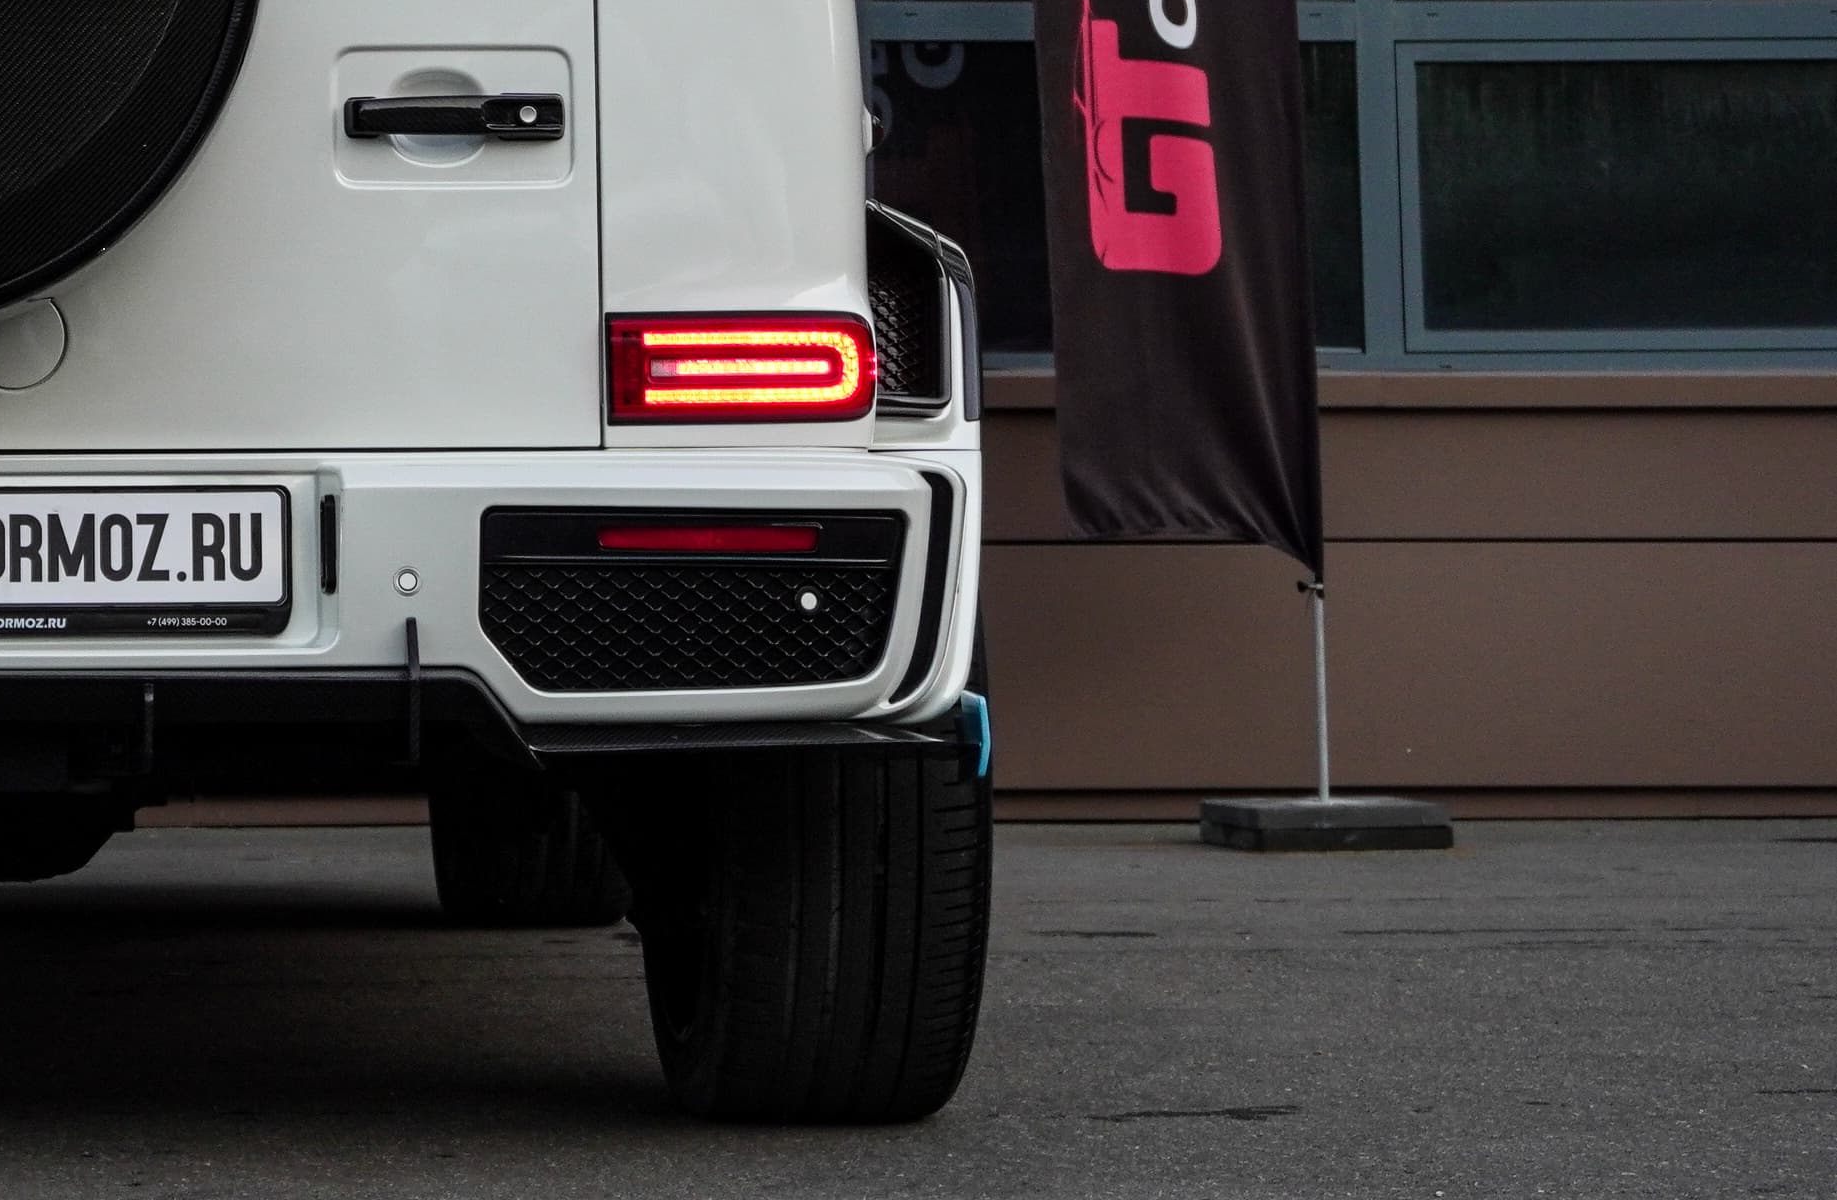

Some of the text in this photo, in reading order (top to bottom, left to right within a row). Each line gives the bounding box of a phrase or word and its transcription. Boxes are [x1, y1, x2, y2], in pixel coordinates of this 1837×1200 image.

[1082, 8, 1222, 276] GT
[158, 617, 180, 628] (499)
[180, 617, 228, 627] 385-00-00
